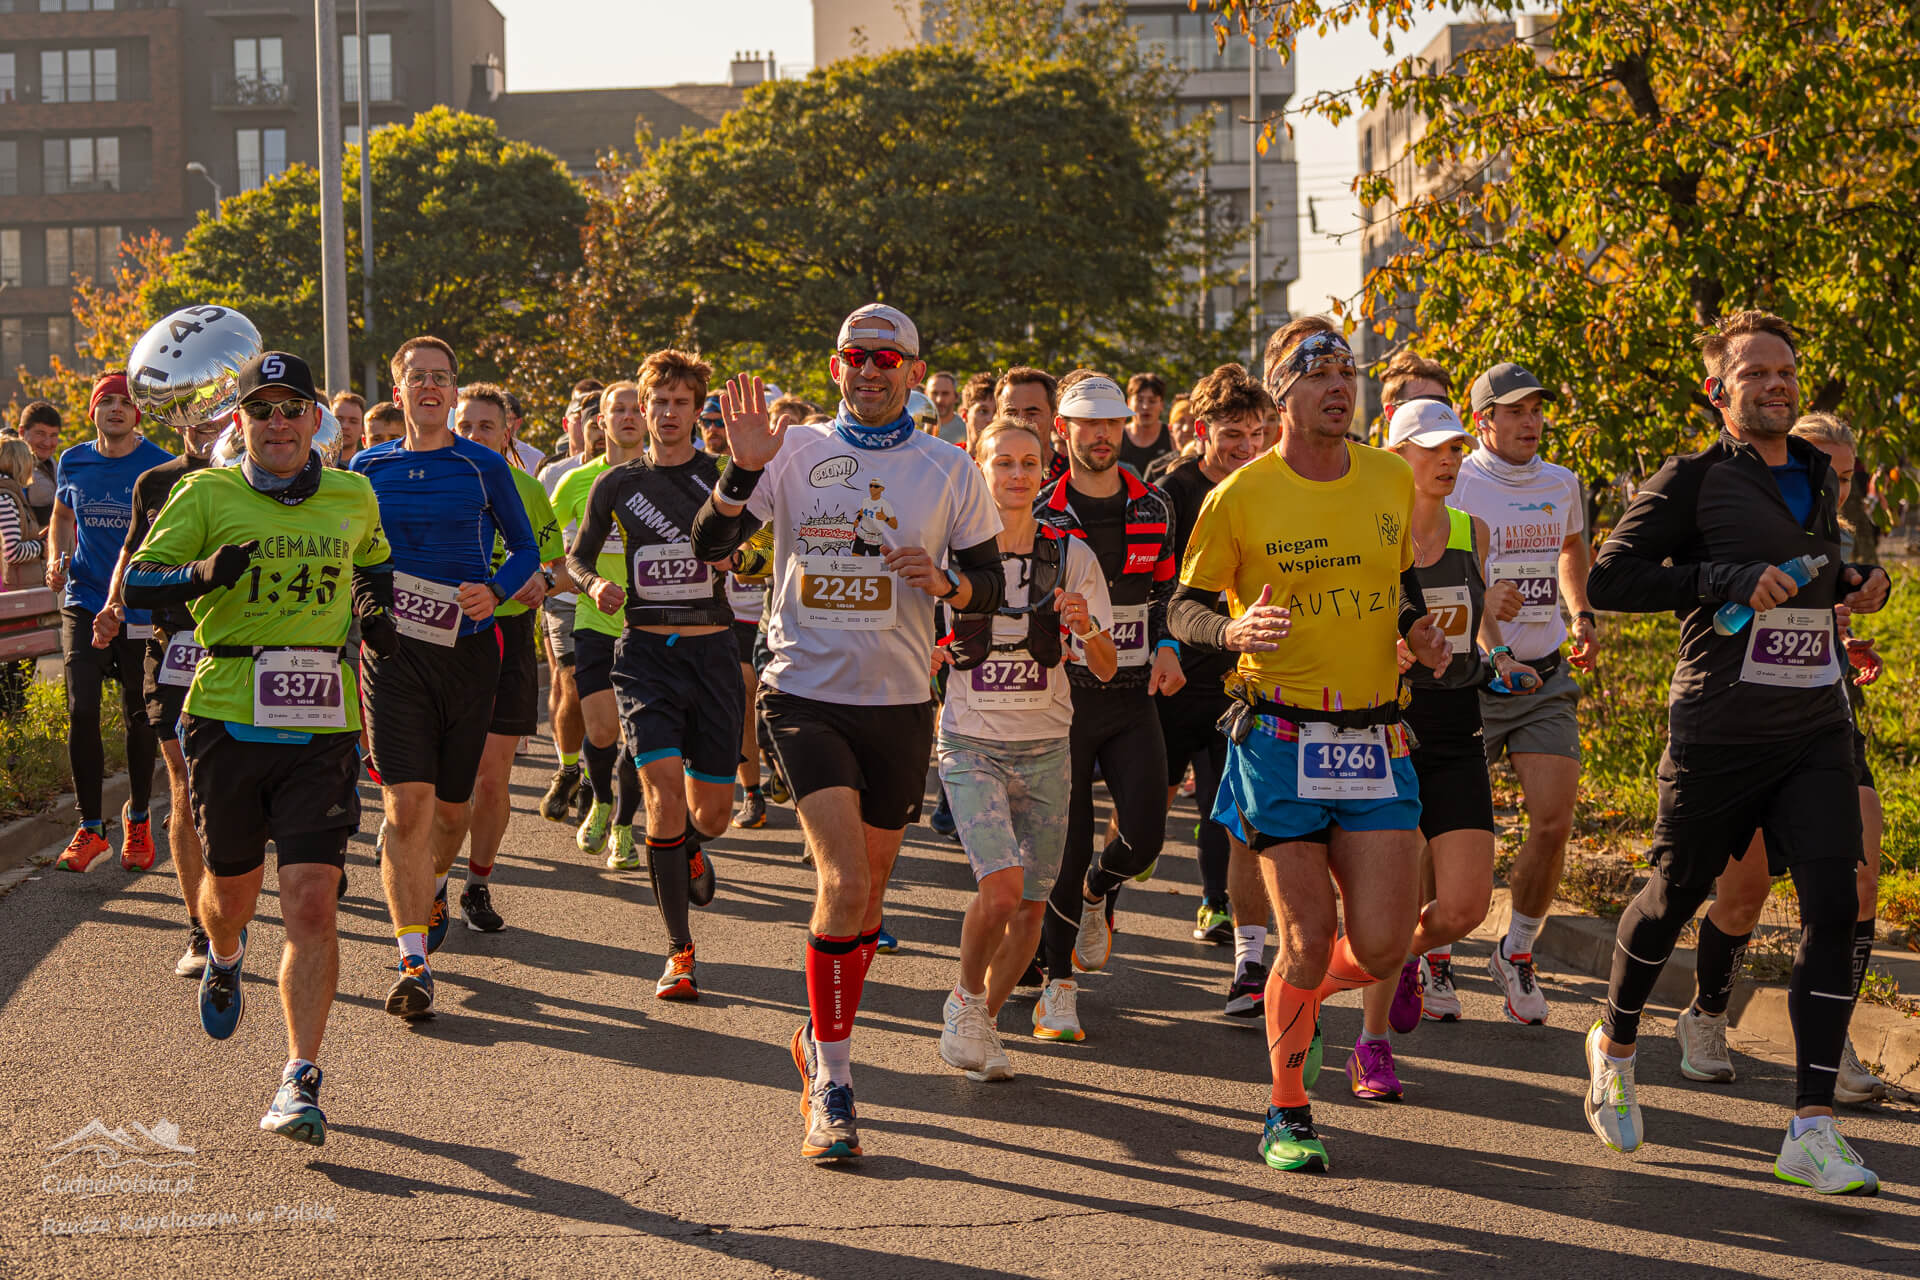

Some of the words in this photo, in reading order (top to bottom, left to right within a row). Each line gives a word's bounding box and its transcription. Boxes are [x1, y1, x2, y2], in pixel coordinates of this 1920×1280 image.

[136, 306, 227, 382] 1:45
[250, 536, 350, 560] ACEMAKER
[1266, 537, 1328, 556] Biegam
[647, 559, 698, 580] 4129
[1278, 554, 1361, 574] Wspieram
[244, 563, 341, 605] 1:45
[813, 576, 879, 601] 2245
[1510, 579, 1553, 599] 464
[395, 591, 451, 621] 3237
[1290, 584, 1397, 620] AUTYZM
[1766, 631, 1823, 656] 3926
[272, 673, 333, 697] 3377
[982, 662, 1040, 684] 3724
[1318, 745, 1376, 770] 1966
